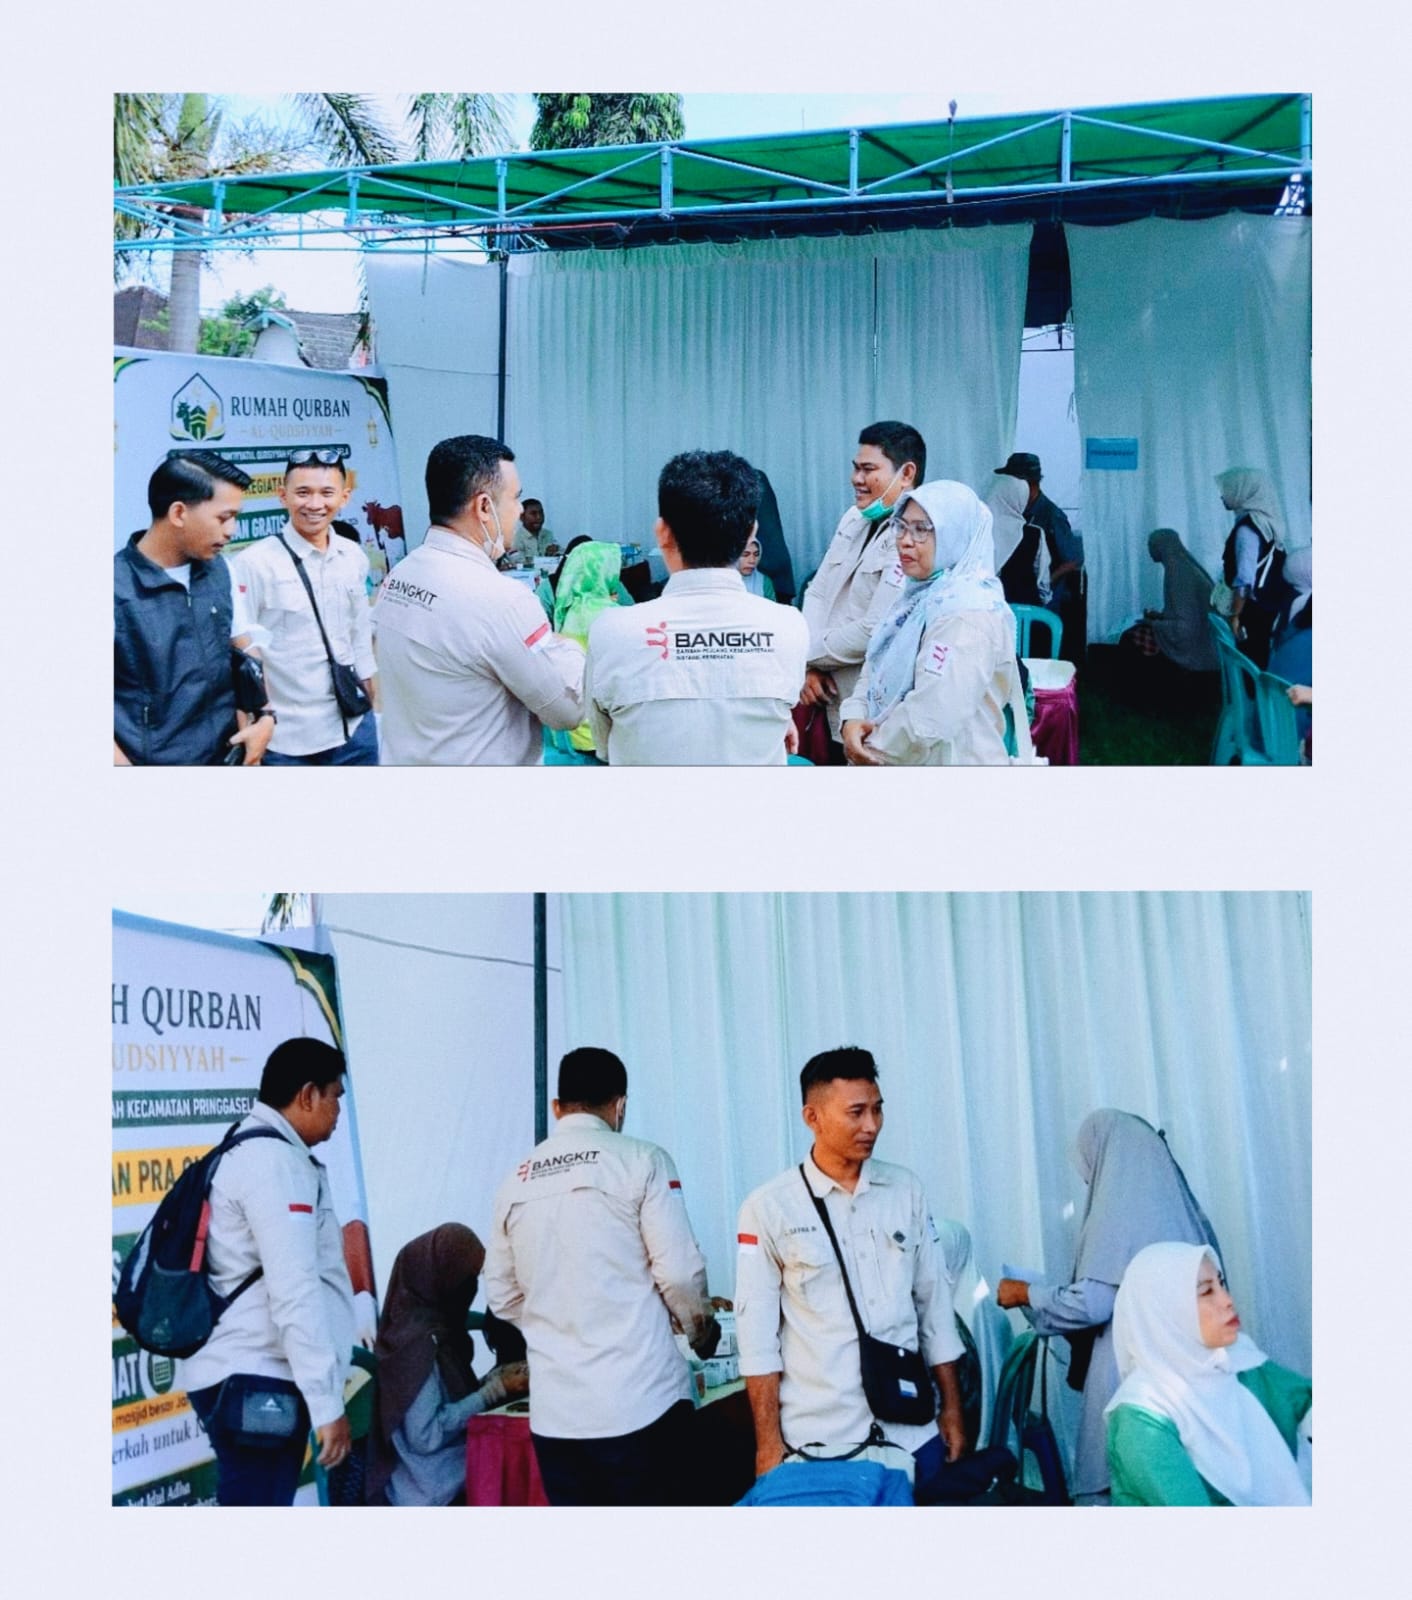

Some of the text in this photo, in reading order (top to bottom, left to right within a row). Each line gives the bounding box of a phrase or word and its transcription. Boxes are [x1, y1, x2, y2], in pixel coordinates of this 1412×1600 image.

[231, 396, 351, 421] RUMAH QURBAN
[252, 514, 287, 537] GRATIS
[388, 579, 438, 605] BANGKIT
[675, 632, 774, 647] BANGKIT
[142, 986, 261, 1036] QURBAN
[127, 1098, 191, 1118] KECAMATAN
[193, 1097, 257, 1116] PRINGGASEL
[532, 1151, 600, 1171] BANGKIT
[138, 1157, 176, 1193] PRA
[153, 1420, 191, 1450] untuk
